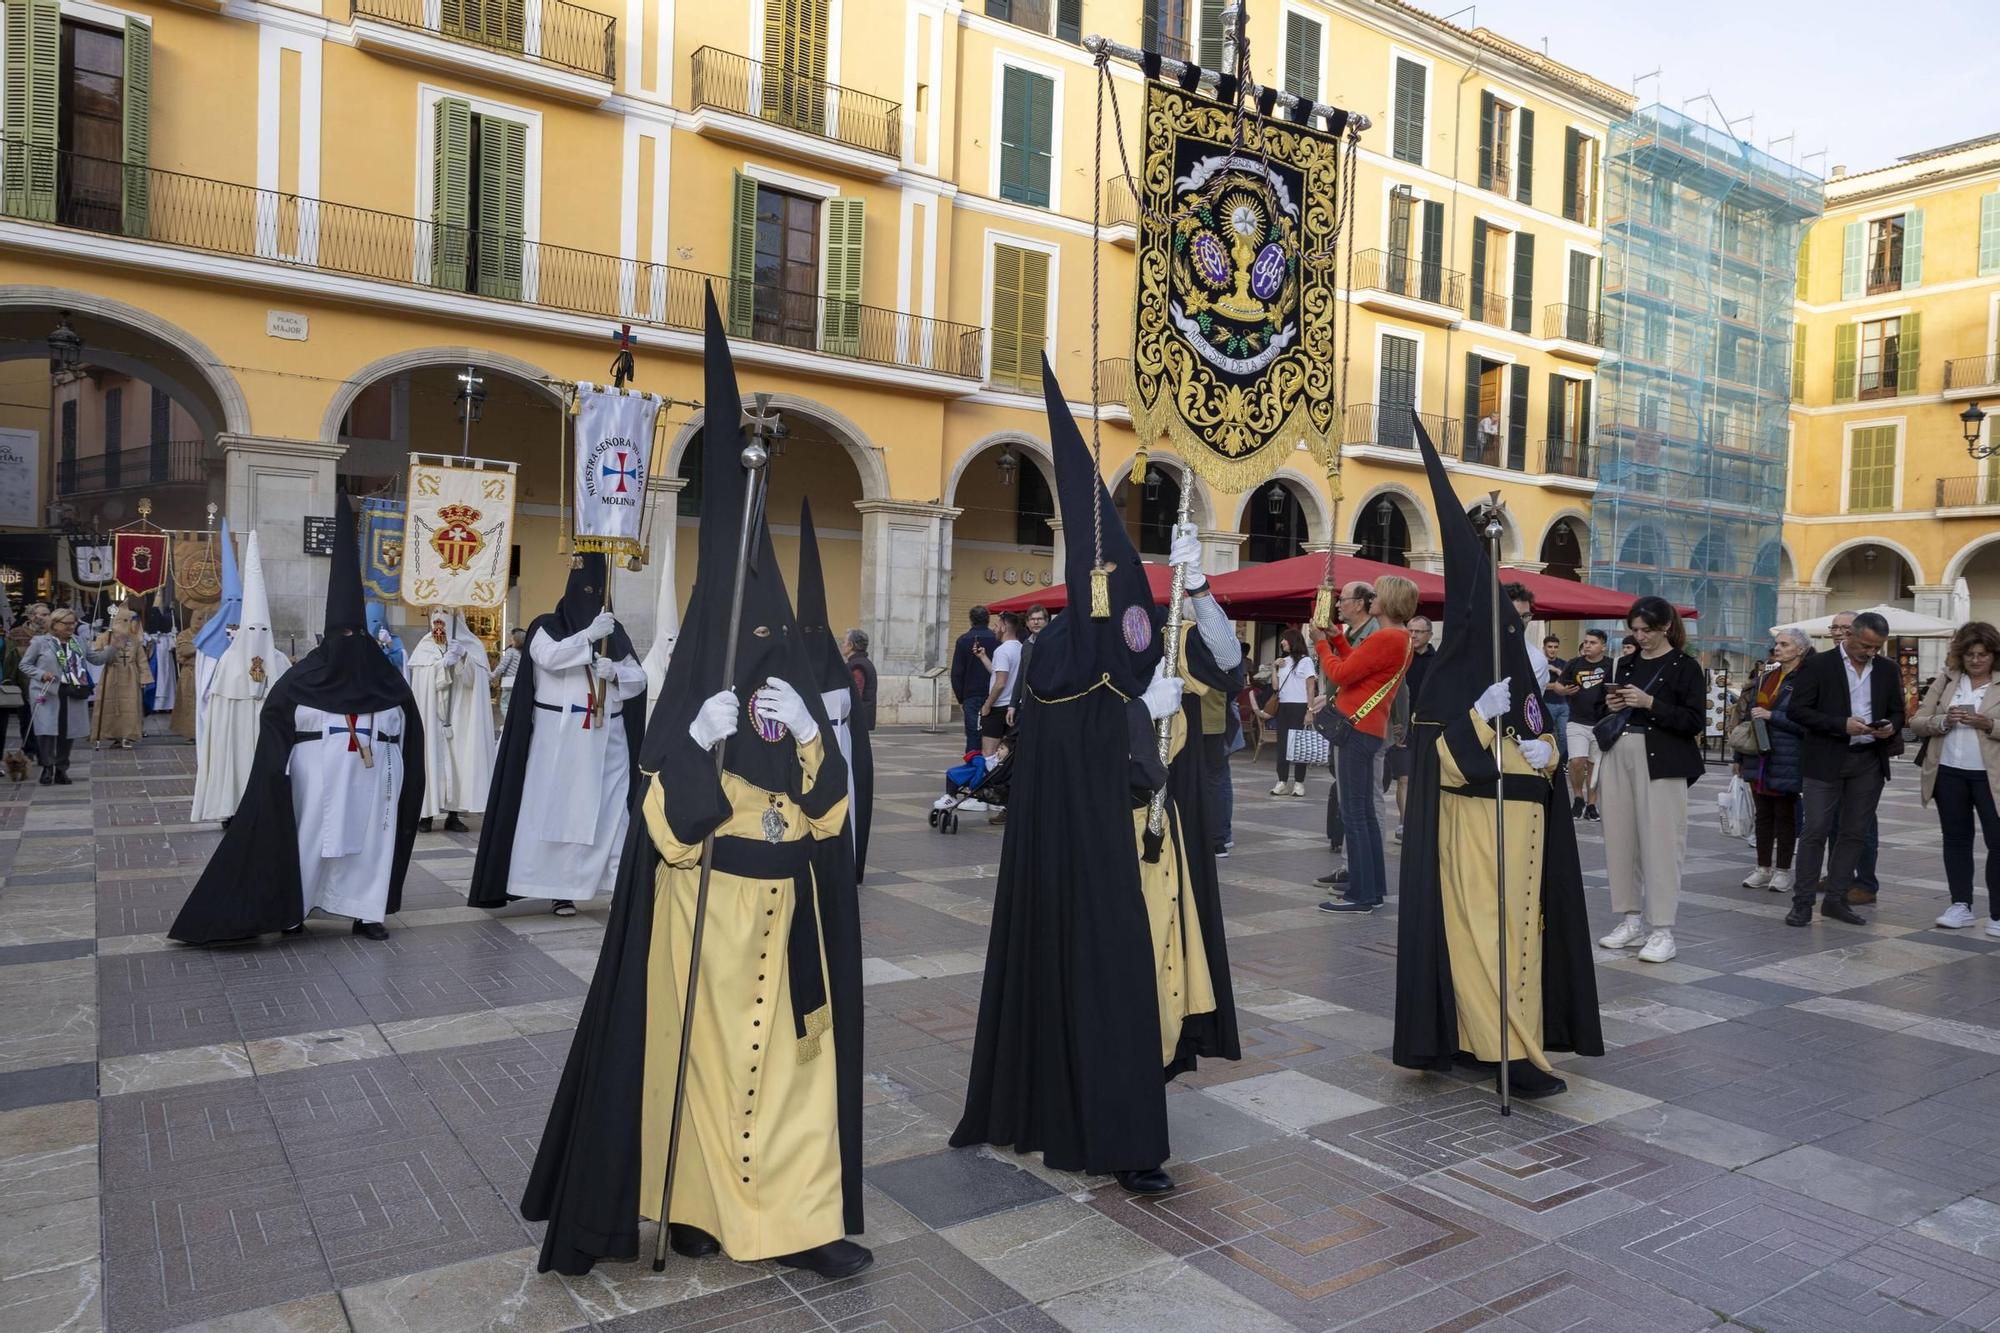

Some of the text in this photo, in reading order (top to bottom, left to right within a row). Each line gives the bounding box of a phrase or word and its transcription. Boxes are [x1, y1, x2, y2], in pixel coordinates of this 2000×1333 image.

[272, 324, 302, 335] MAJOR
[1231, 359, 1244, 373] DE
[1246, 361, 1258, 372] LA
[586, 454, 599, 497] NUESTRA
[595, 437, 631, 455] SEÑORA
[601, 496, 636, 507] MOLINR
